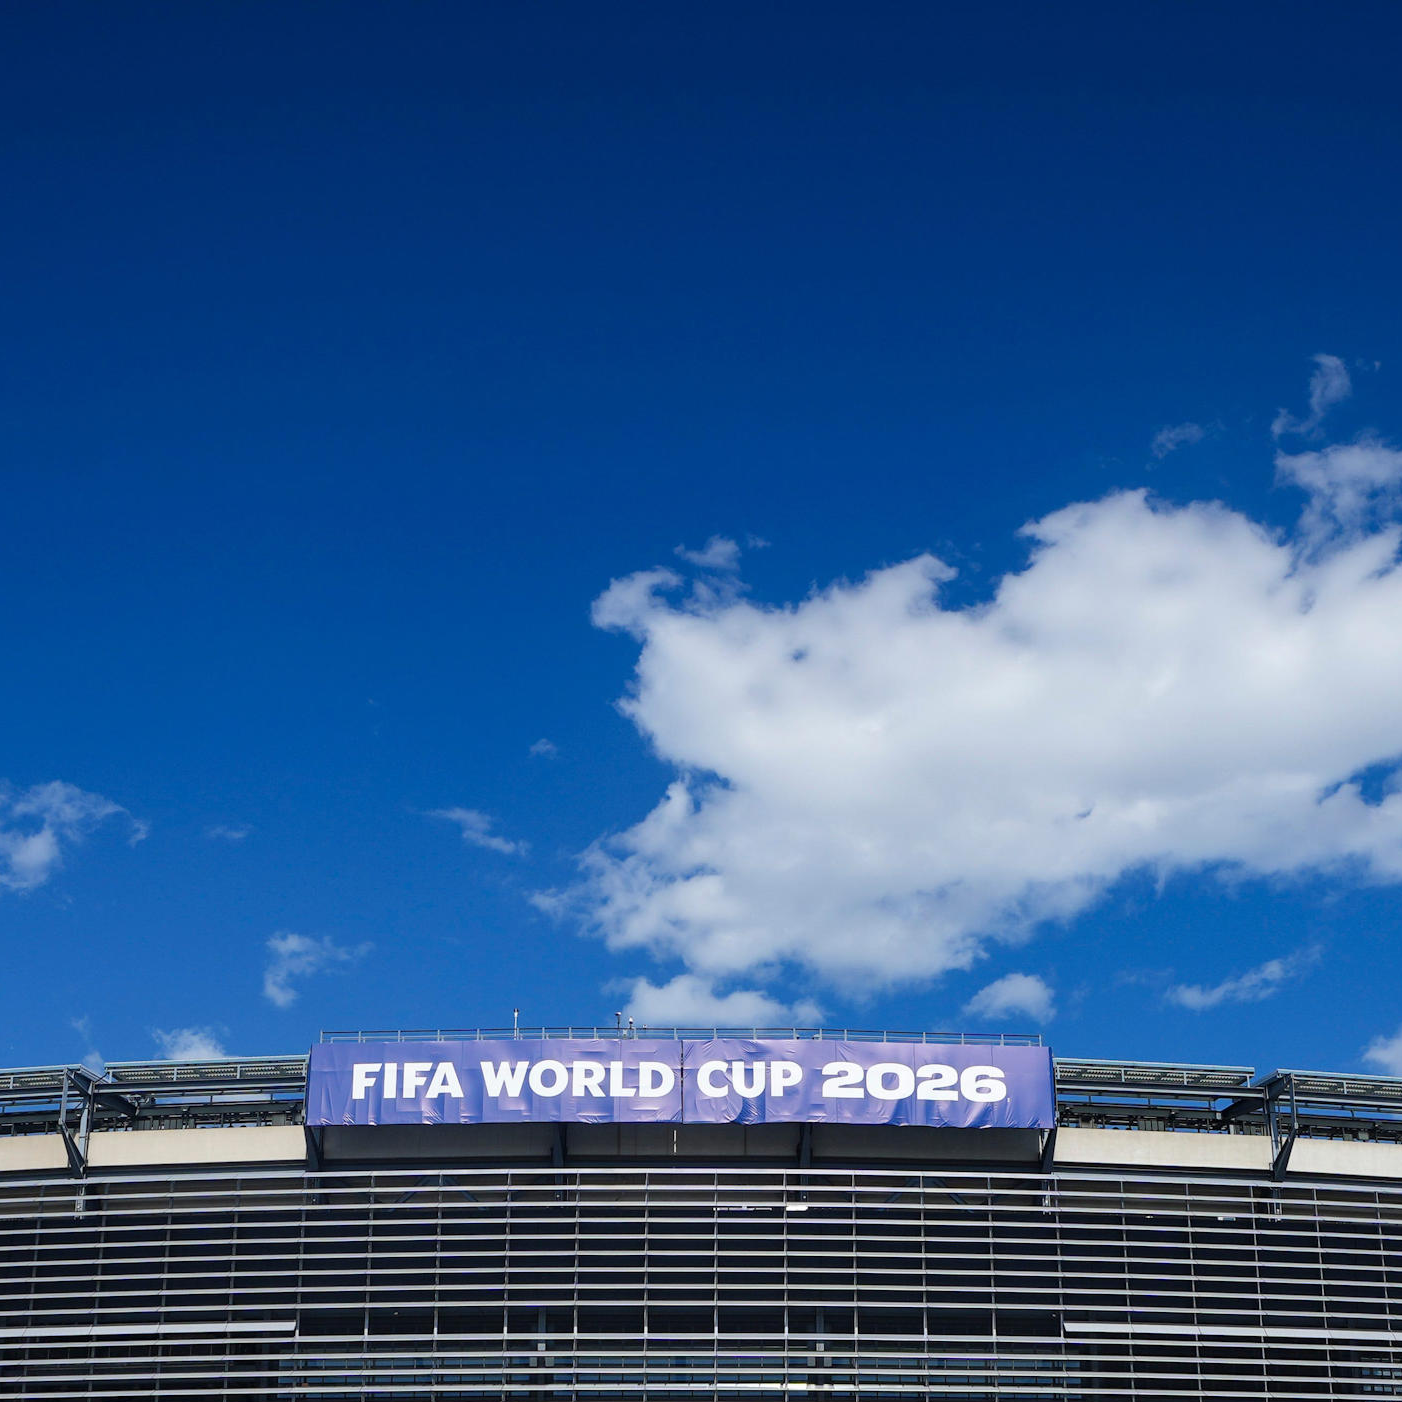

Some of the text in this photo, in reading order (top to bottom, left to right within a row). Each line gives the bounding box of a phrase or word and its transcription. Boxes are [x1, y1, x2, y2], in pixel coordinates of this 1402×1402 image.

[352, 1060, 1007, 1103] FIFA WORLD CUP 2026
